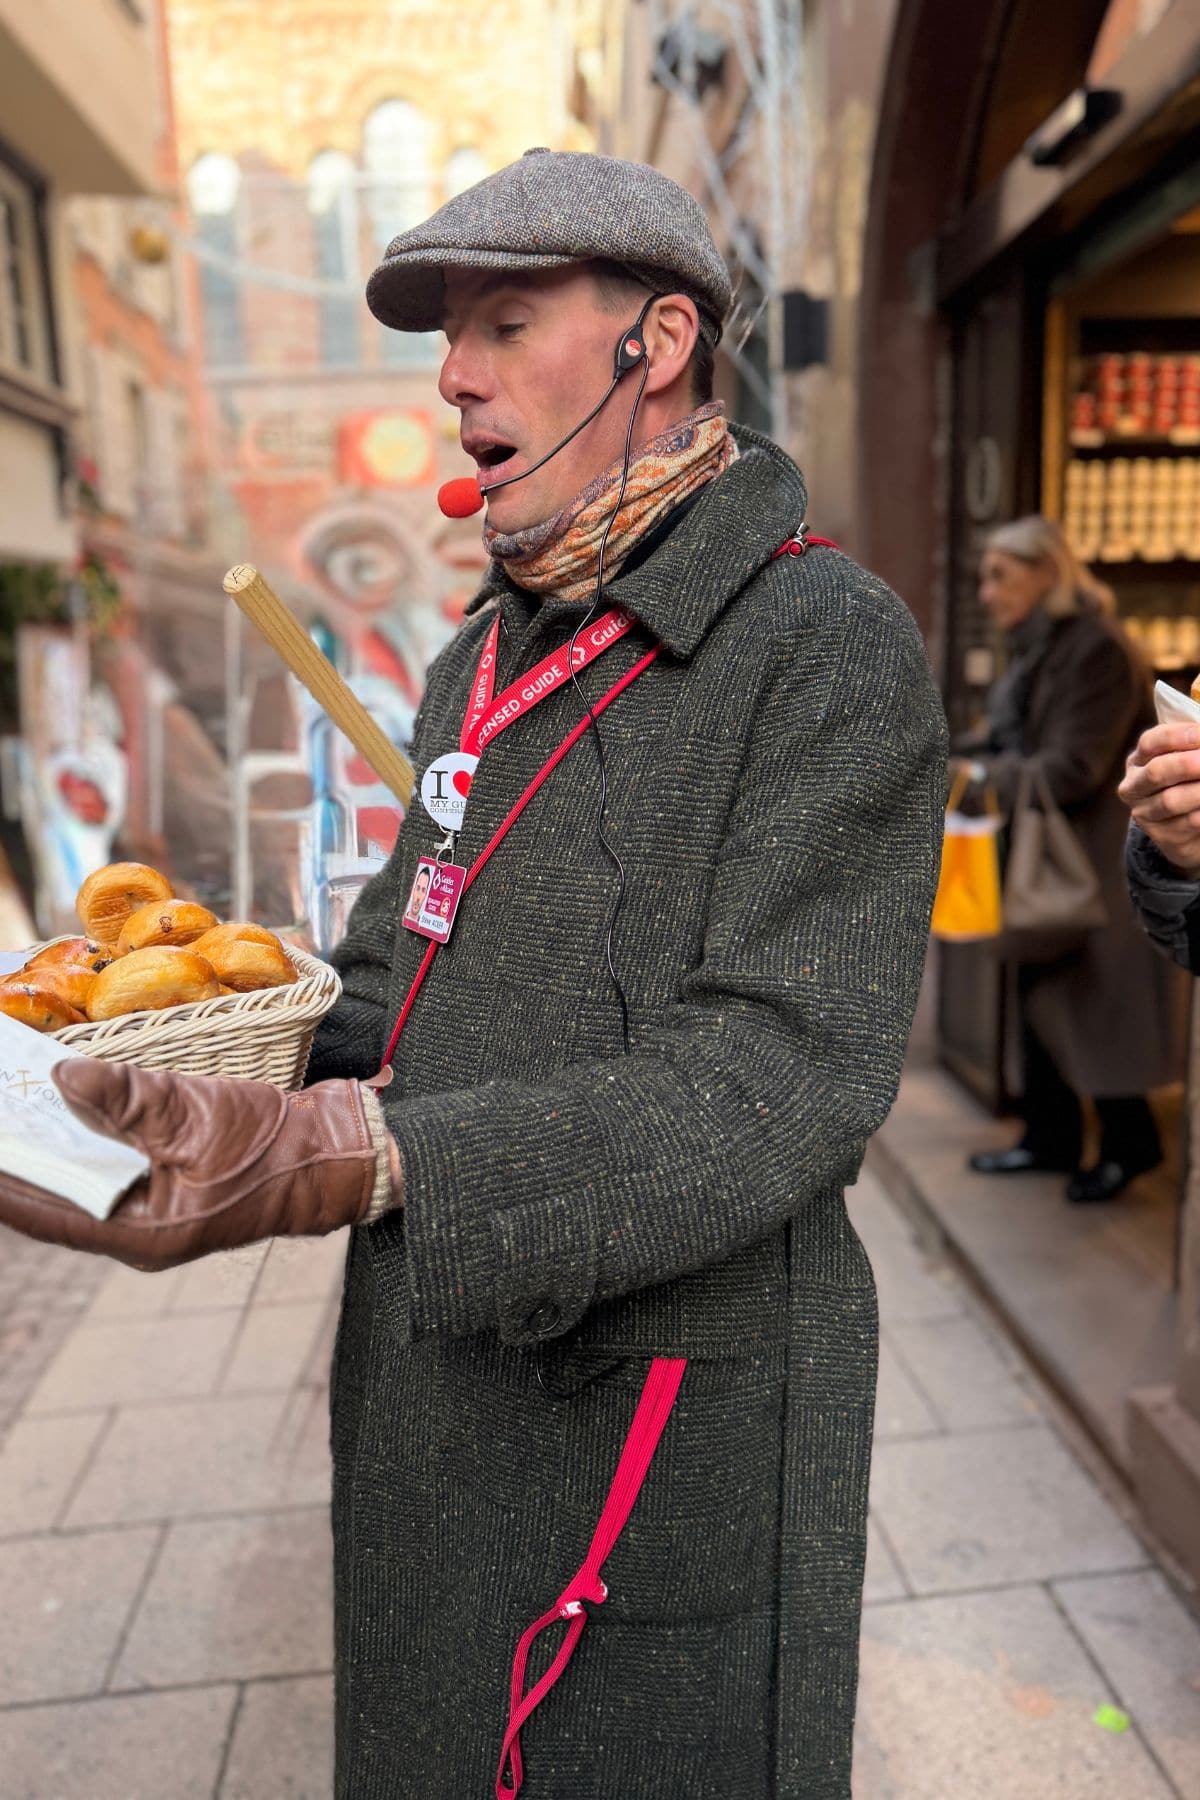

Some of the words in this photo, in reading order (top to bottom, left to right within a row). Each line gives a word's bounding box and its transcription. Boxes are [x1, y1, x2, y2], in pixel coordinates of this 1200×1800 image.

[474, 673, 489, 710] GUIDE
[522, 664, 564, 701] GUIDE
[430, 770, 448, 799] I
[430, 800, 448, 808] MY
